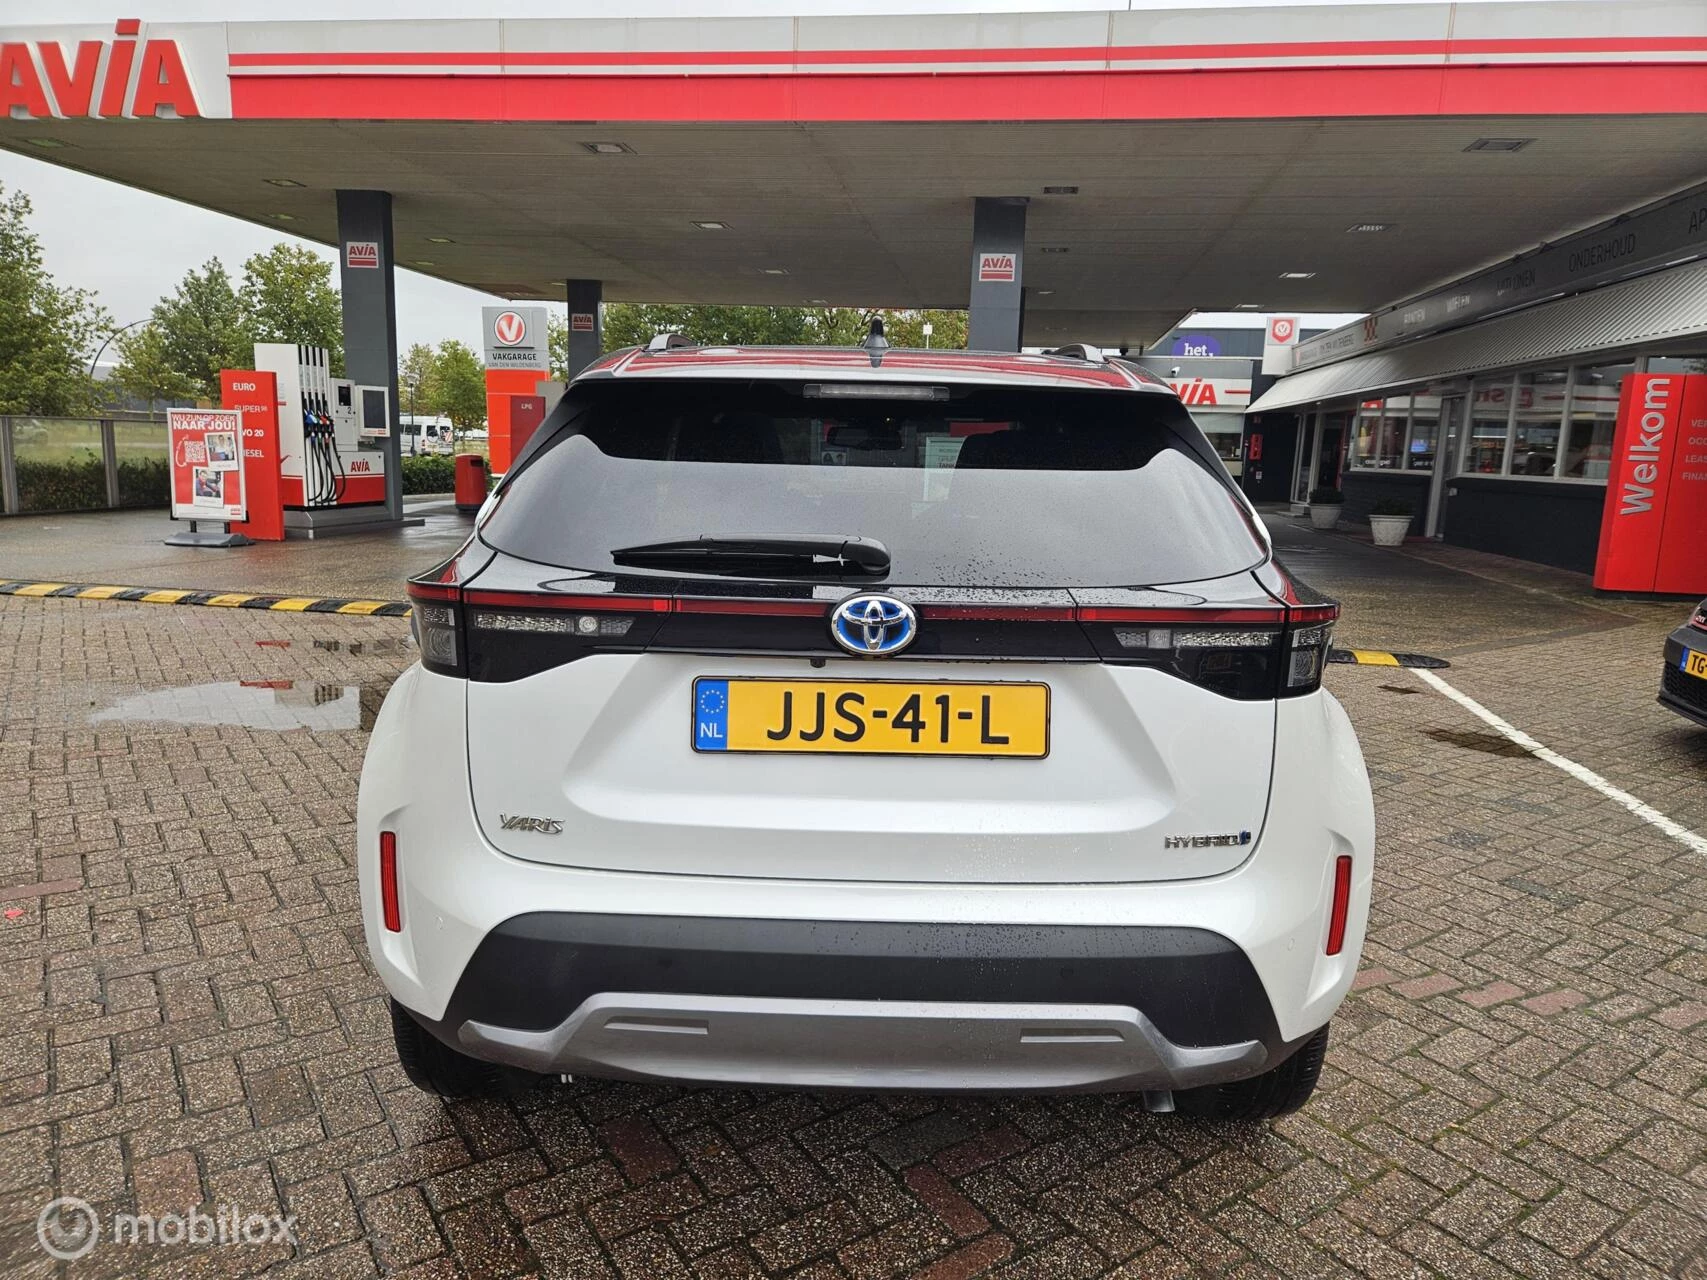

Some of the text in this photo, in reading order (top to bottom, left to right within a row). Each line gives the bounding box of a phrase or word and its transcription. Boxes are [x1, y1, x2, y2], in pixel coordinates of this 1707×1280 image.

[348, 244, 376, 257] AVIA
[1568, 233, 1636, 273] ONDERHOUD
[982, 255, 1013, 269] AVIA
[492, 353, 537, 361] VAKGARAGE
[232, 382, 256, 392] EURO
[234, 404, 260, 413] SUPER
[347, 406, 352, 415] 2
[173, 421, 236, 431] NAAR JOU!
[1620, 378, 1671, 515] Welkom
[243, 449, 265, 458] IESEL
[350, 458, 370, 473] AVIA
[700, 691, 1010, 745] NL JJS-41-L
[1164, 833, 1240, 850] HYBRID
